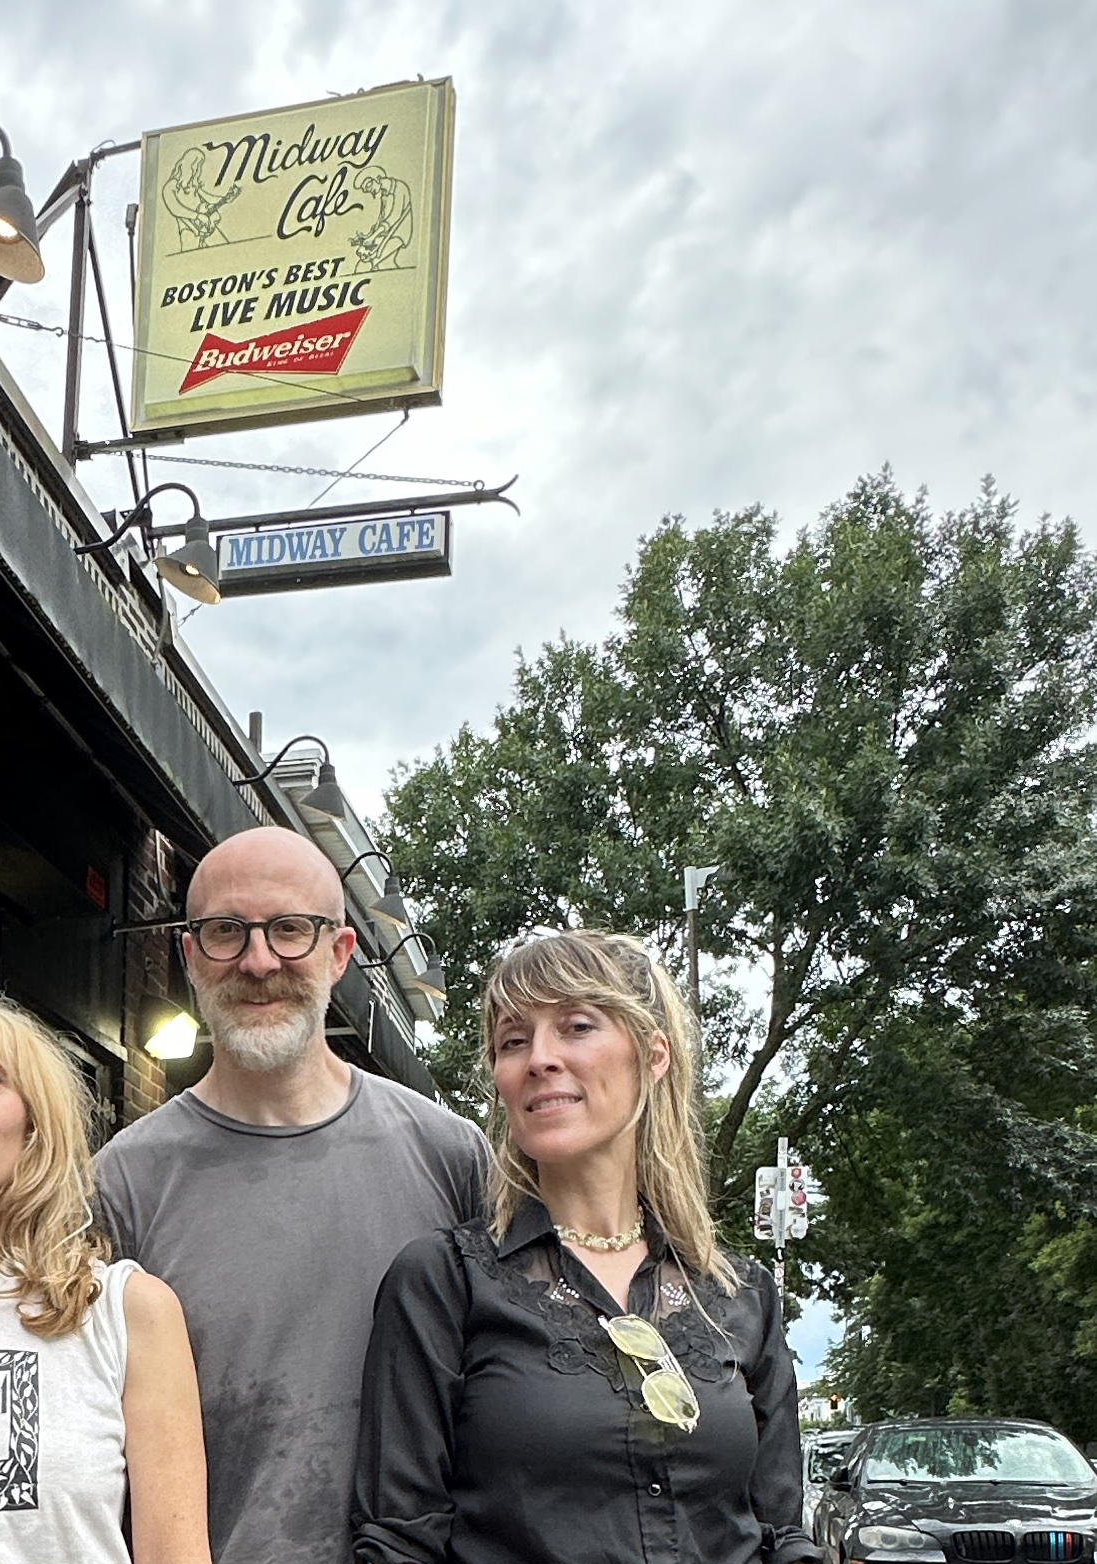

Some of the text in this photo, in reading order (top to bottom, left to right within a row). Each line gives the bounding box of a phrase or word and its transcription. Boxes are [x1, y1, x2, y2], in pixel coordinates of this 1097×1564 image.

[202, 123, 389, 188] Midway
[276, 166, 364, 240] Cafe
[160, 256, 346, 309] BOSTON'S BEST
[190, 278, 372, 333] LIVE MUSIC
[192, 333, 352, 373] Budweiser
[226, 518, 436, 568] MIDWAY CAFE
